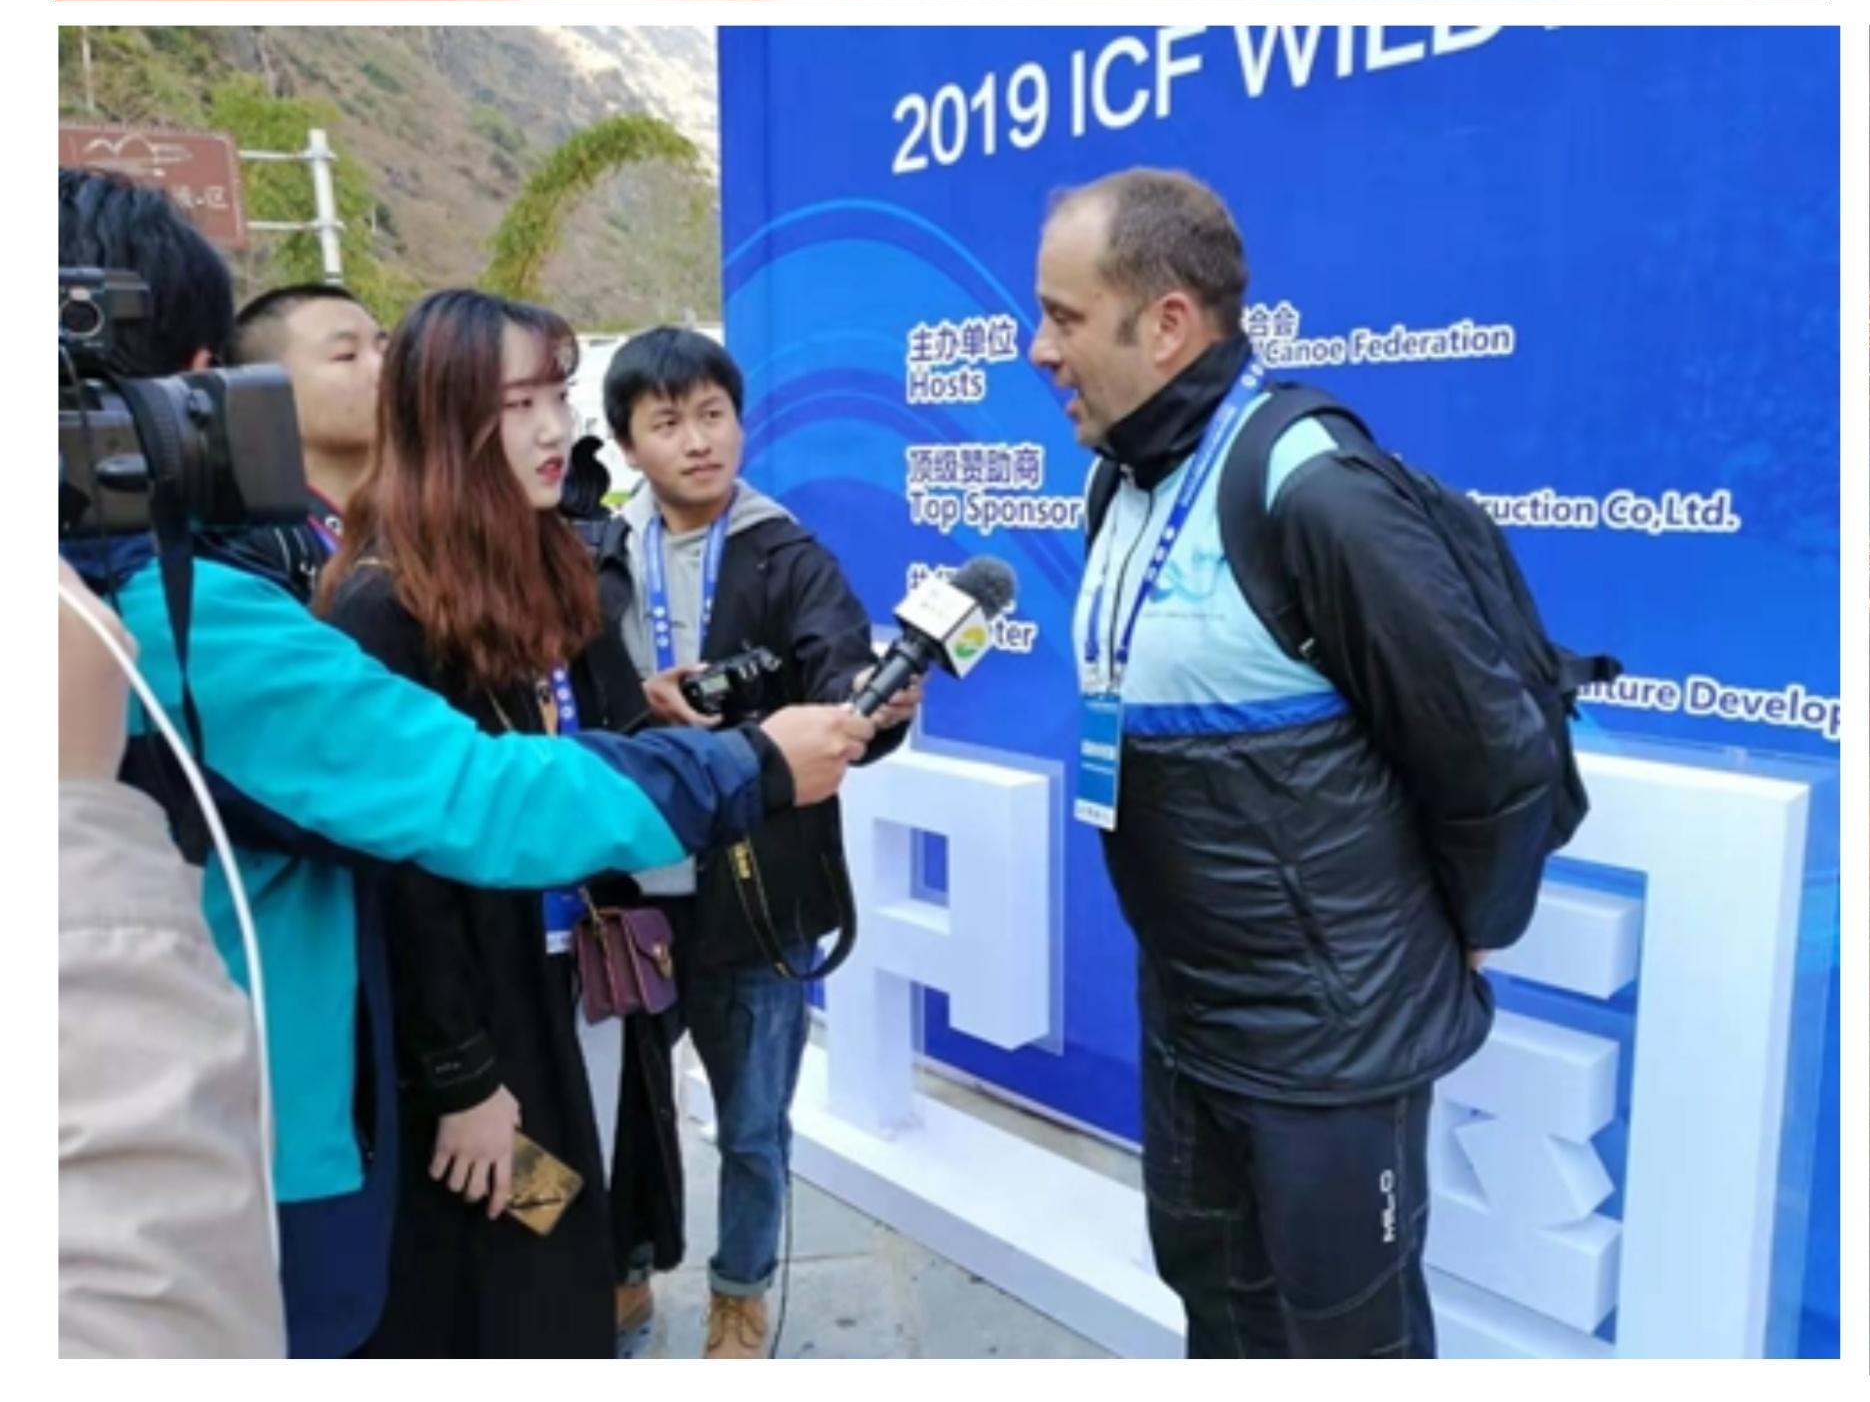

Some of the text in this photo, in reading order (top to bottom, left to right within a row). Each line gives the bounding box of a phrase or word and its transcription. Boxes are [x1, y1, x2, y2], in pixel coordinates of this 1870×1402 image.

[891, 63, 1049, 174] 2019
[1071, 26, 1205, 137] ICF
[909, 318, 1015, 362] 主办单位
[1354, 323, 1511, 359] Federation
[909, 369, 983, 398] Hosts
[909, 491, 1082, 529] Top Sponsor
